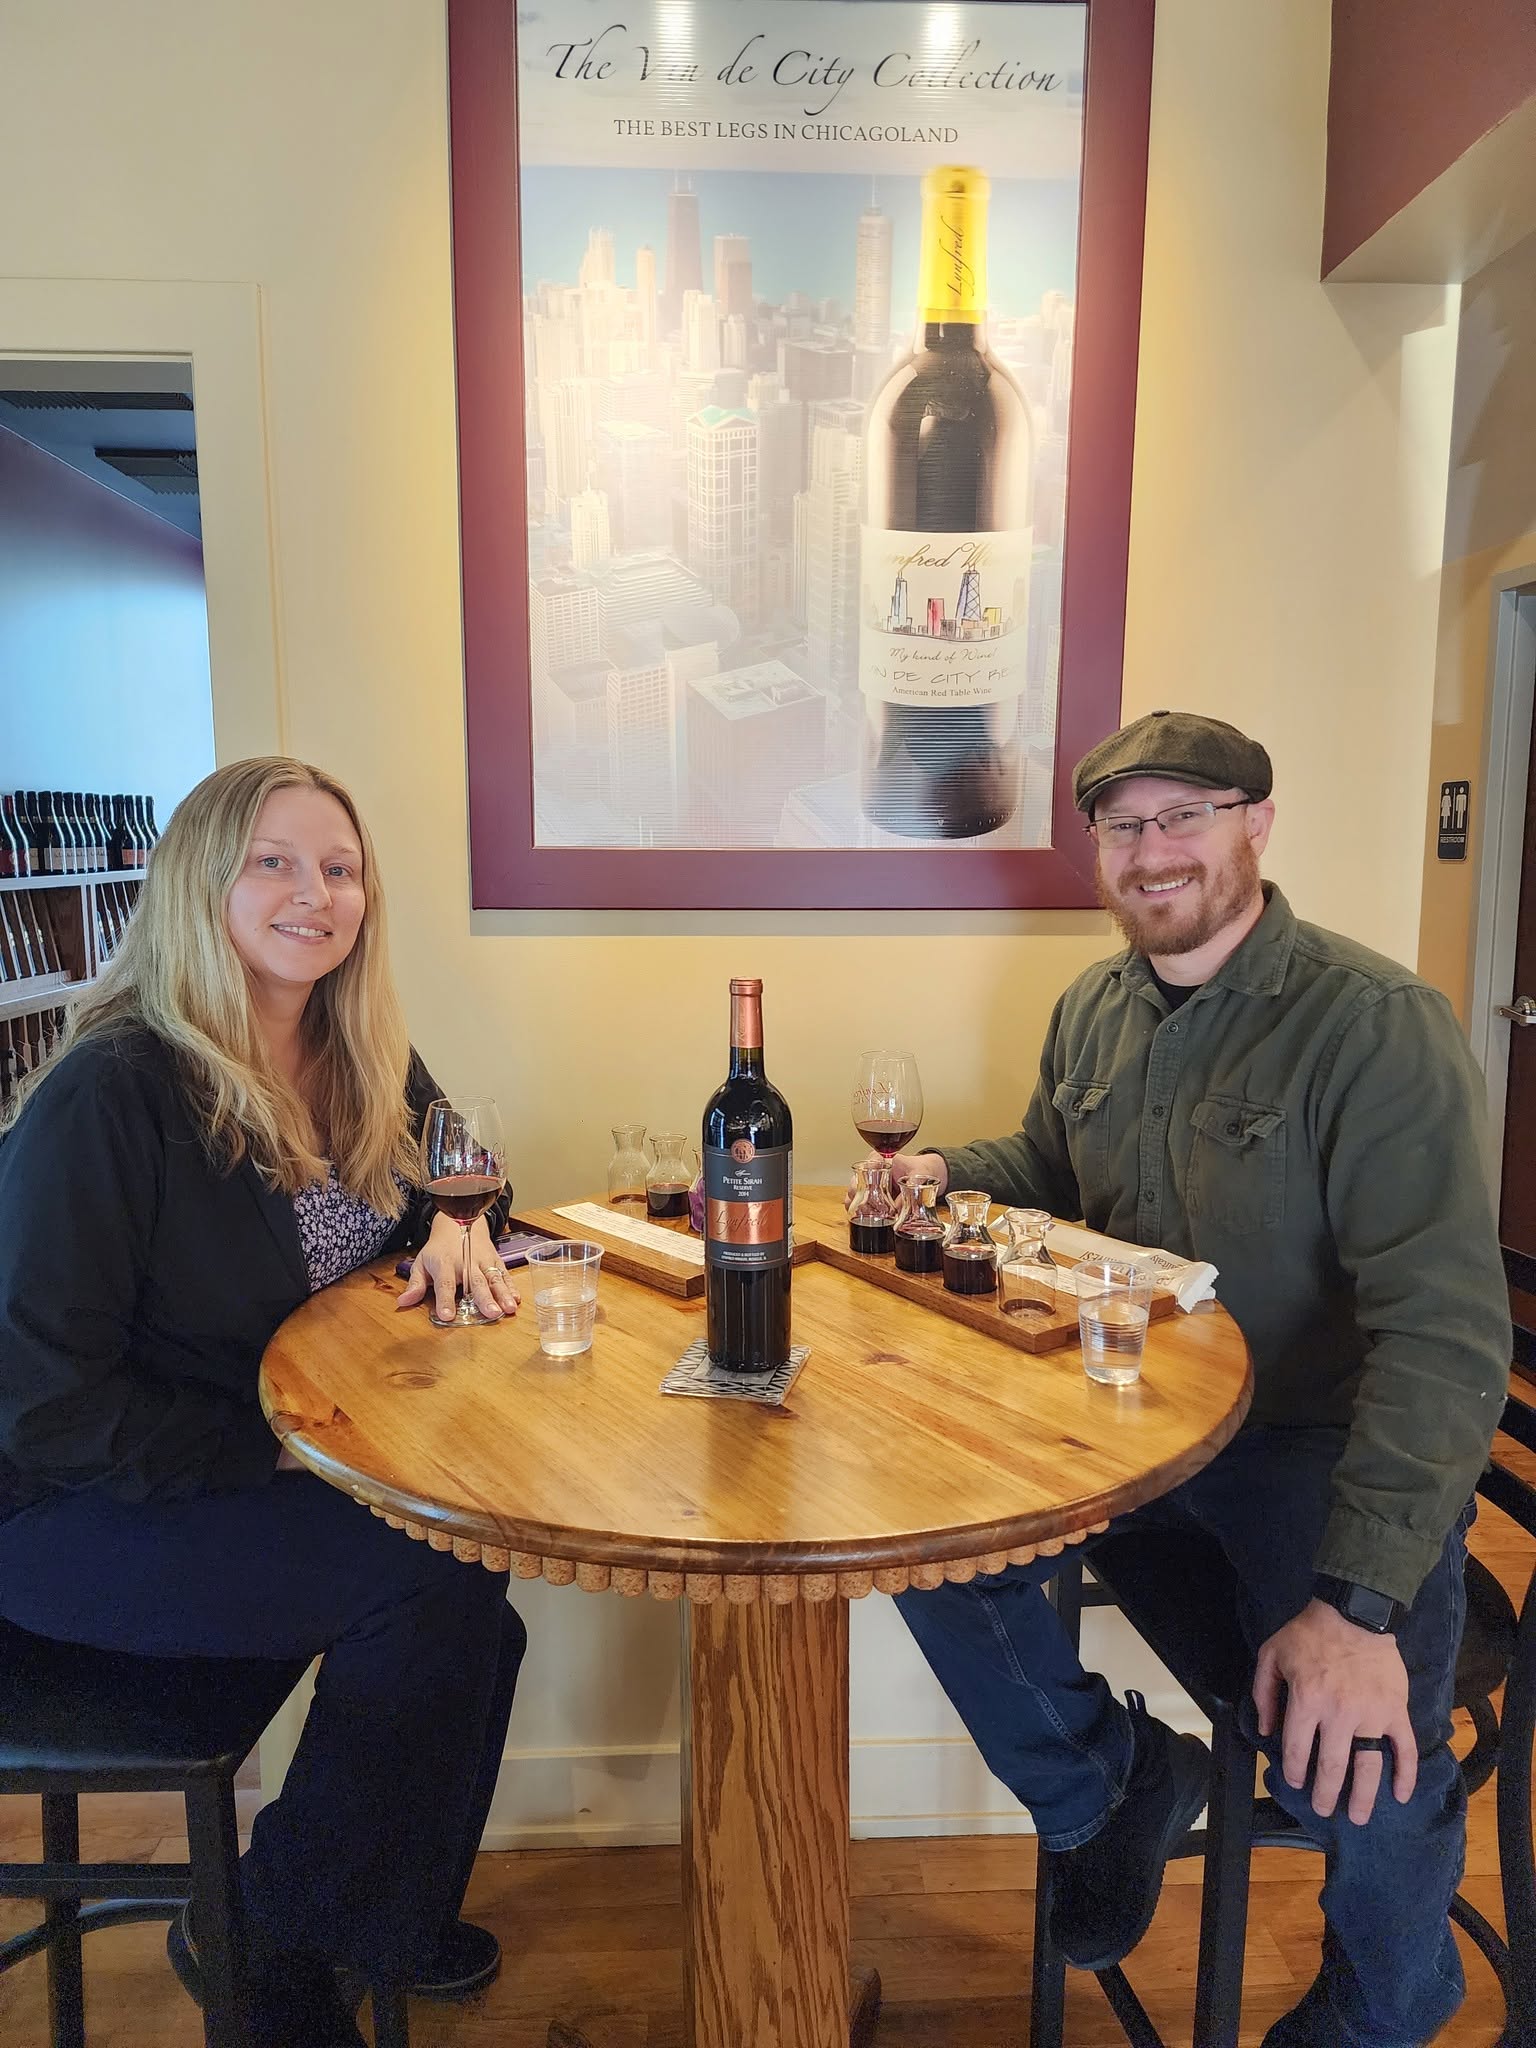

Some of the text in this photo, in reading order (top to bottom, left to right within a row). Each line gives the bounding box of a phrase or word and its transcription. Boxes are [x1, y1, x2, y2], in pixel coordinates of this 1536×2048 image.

[546, 24, 627, 81] The
[716, 35, 765, 85] de
[772, 49, 854, 116] City
[872, 38, 1063, 92] Collection
[613, 119, 959, 144] THE BEST LEGS IN CHICAGOLAND
[938, 215, 975, 297] Lynfred
[889, 543, 959, 570] nfred
[889, 647, 909, 663] My
[944, 650, 956, 664] of
[893, 670, 921, 682] DE
[930, 669, 981, 685] CITY
[892, 686, 992, 697] American Red Table Wine
